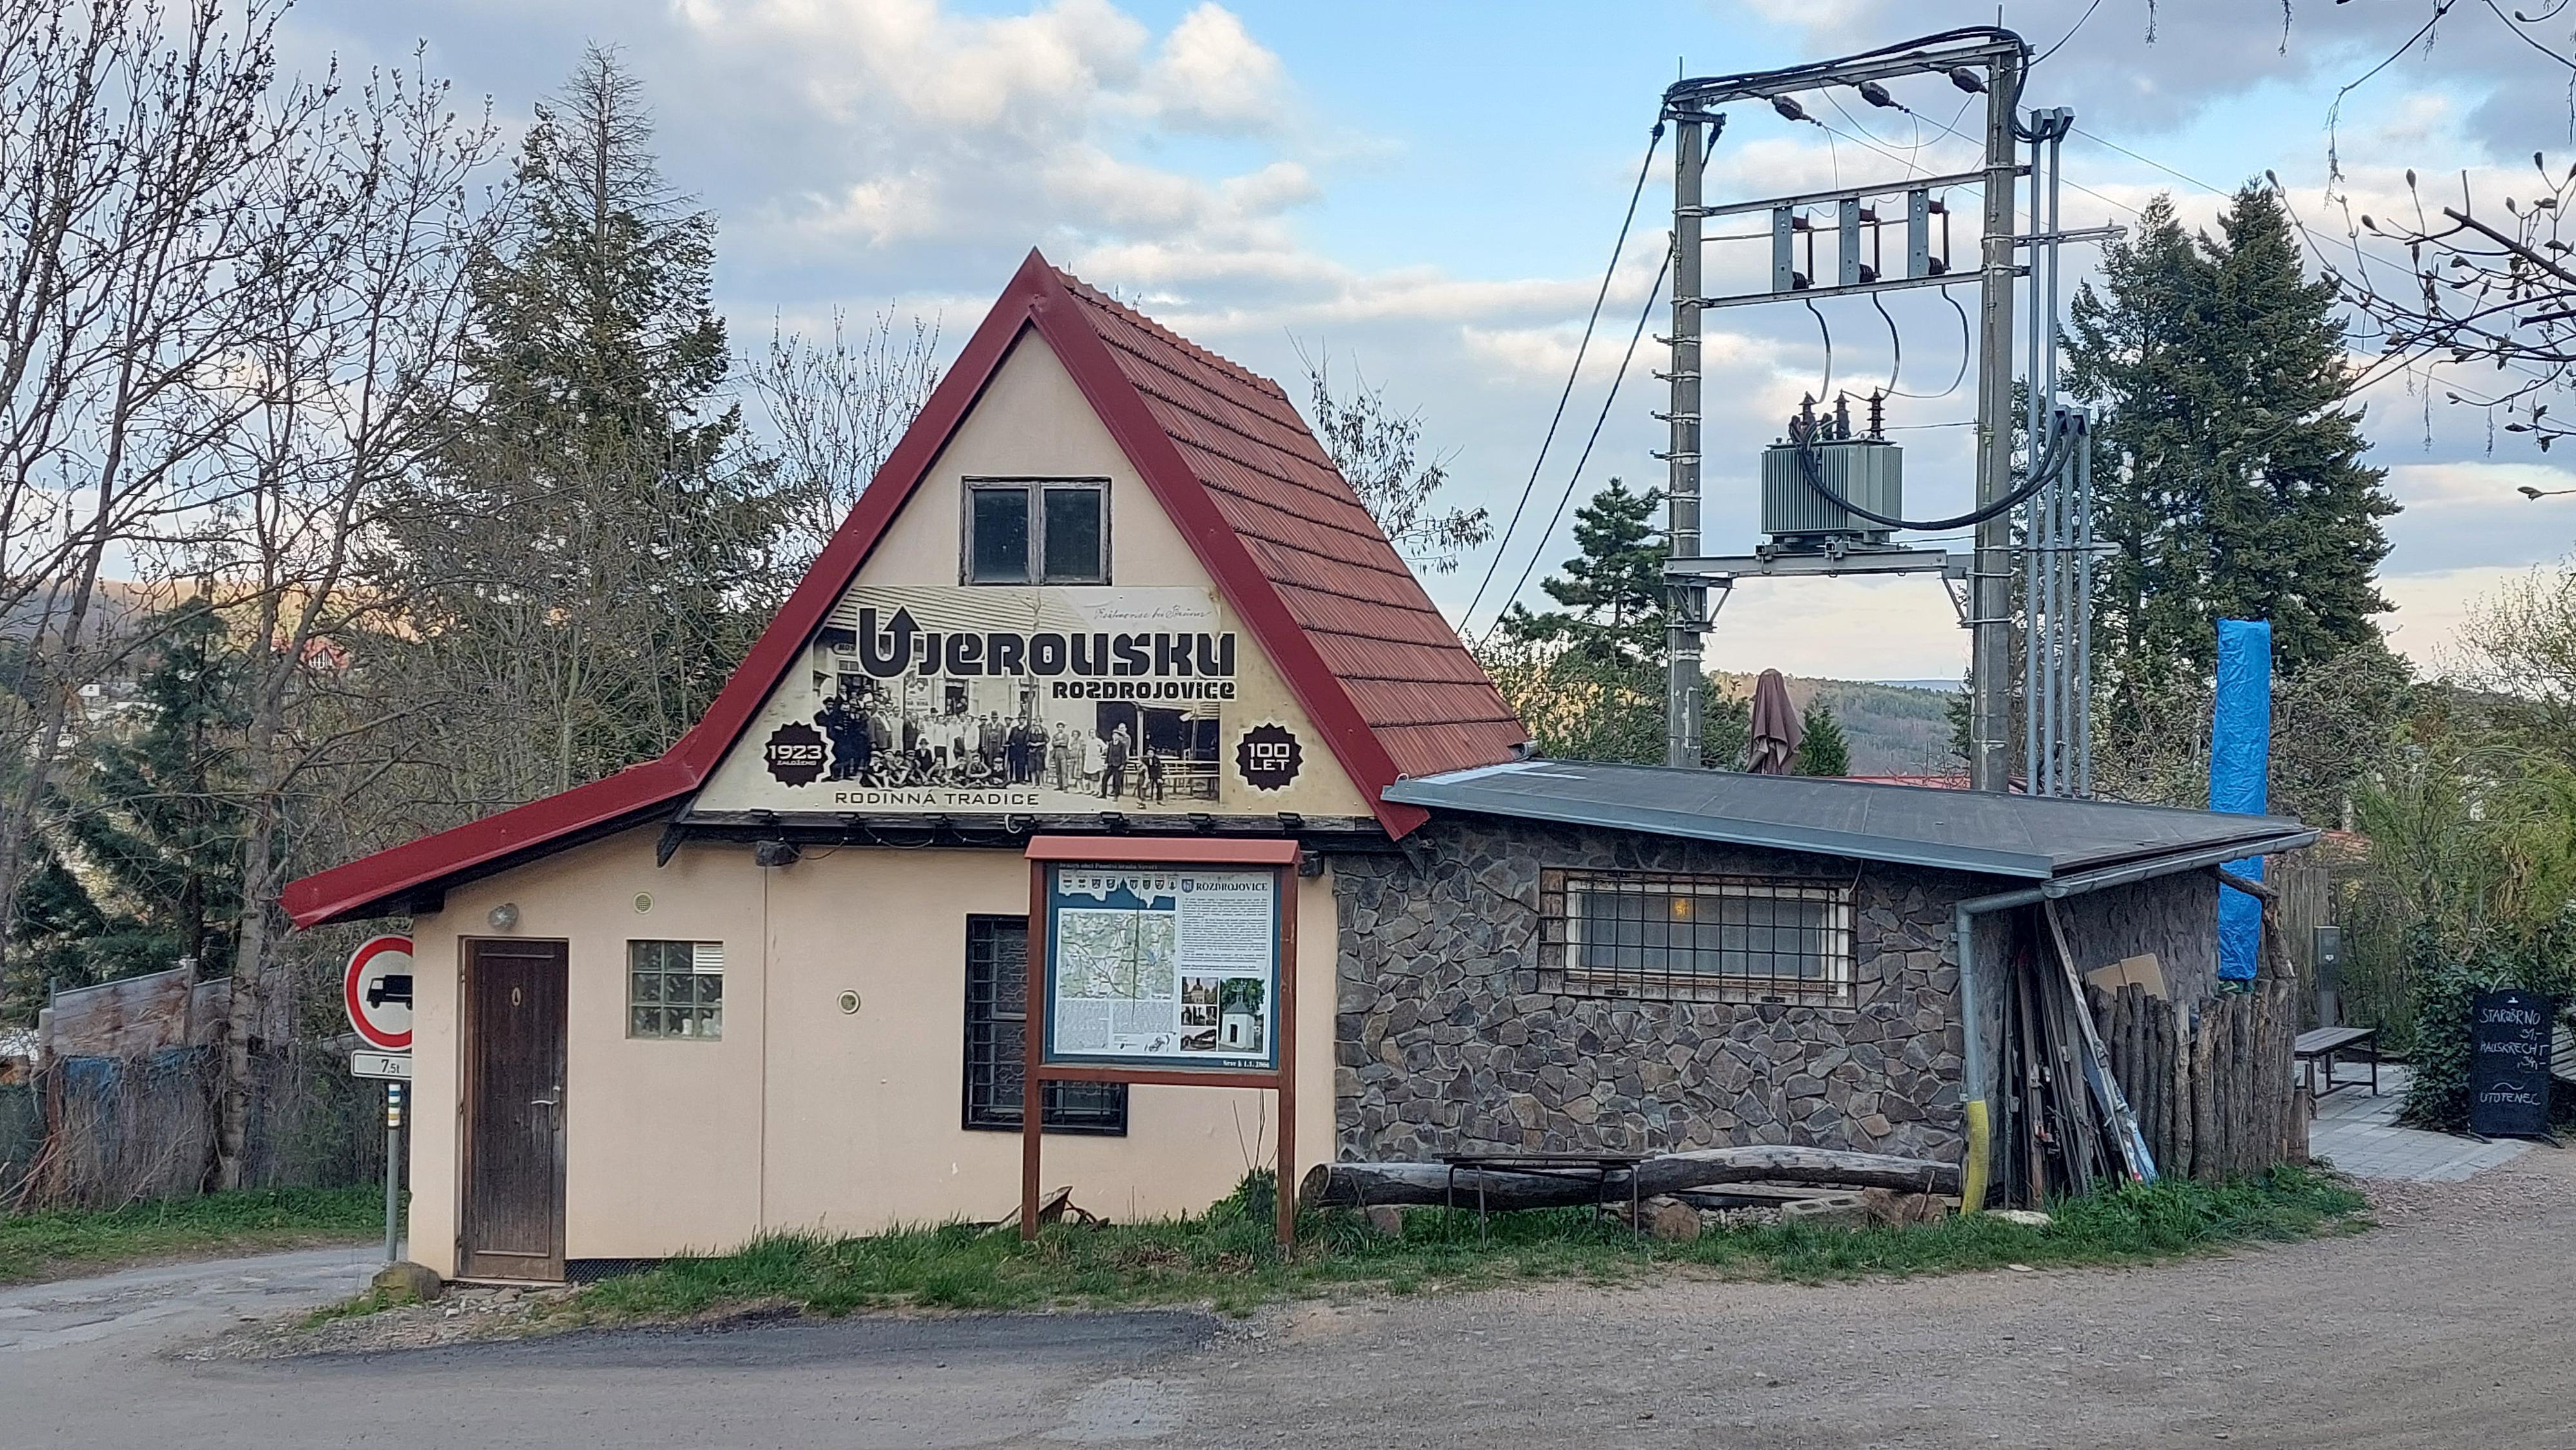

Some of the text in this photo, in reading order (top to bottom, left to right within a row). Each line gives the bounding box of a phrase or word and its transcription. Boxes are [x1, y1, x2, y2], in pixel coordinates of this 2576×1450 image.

[769, 745, 822, 760] 1923
[1247, 743, 1290, 758] 100
[1250, 759, 1290, 771] LET
[835, 789, 1039, 805] RODINNÁ TRADICE
[1196, 882, 1267, 891] ROZDROJOVICE
